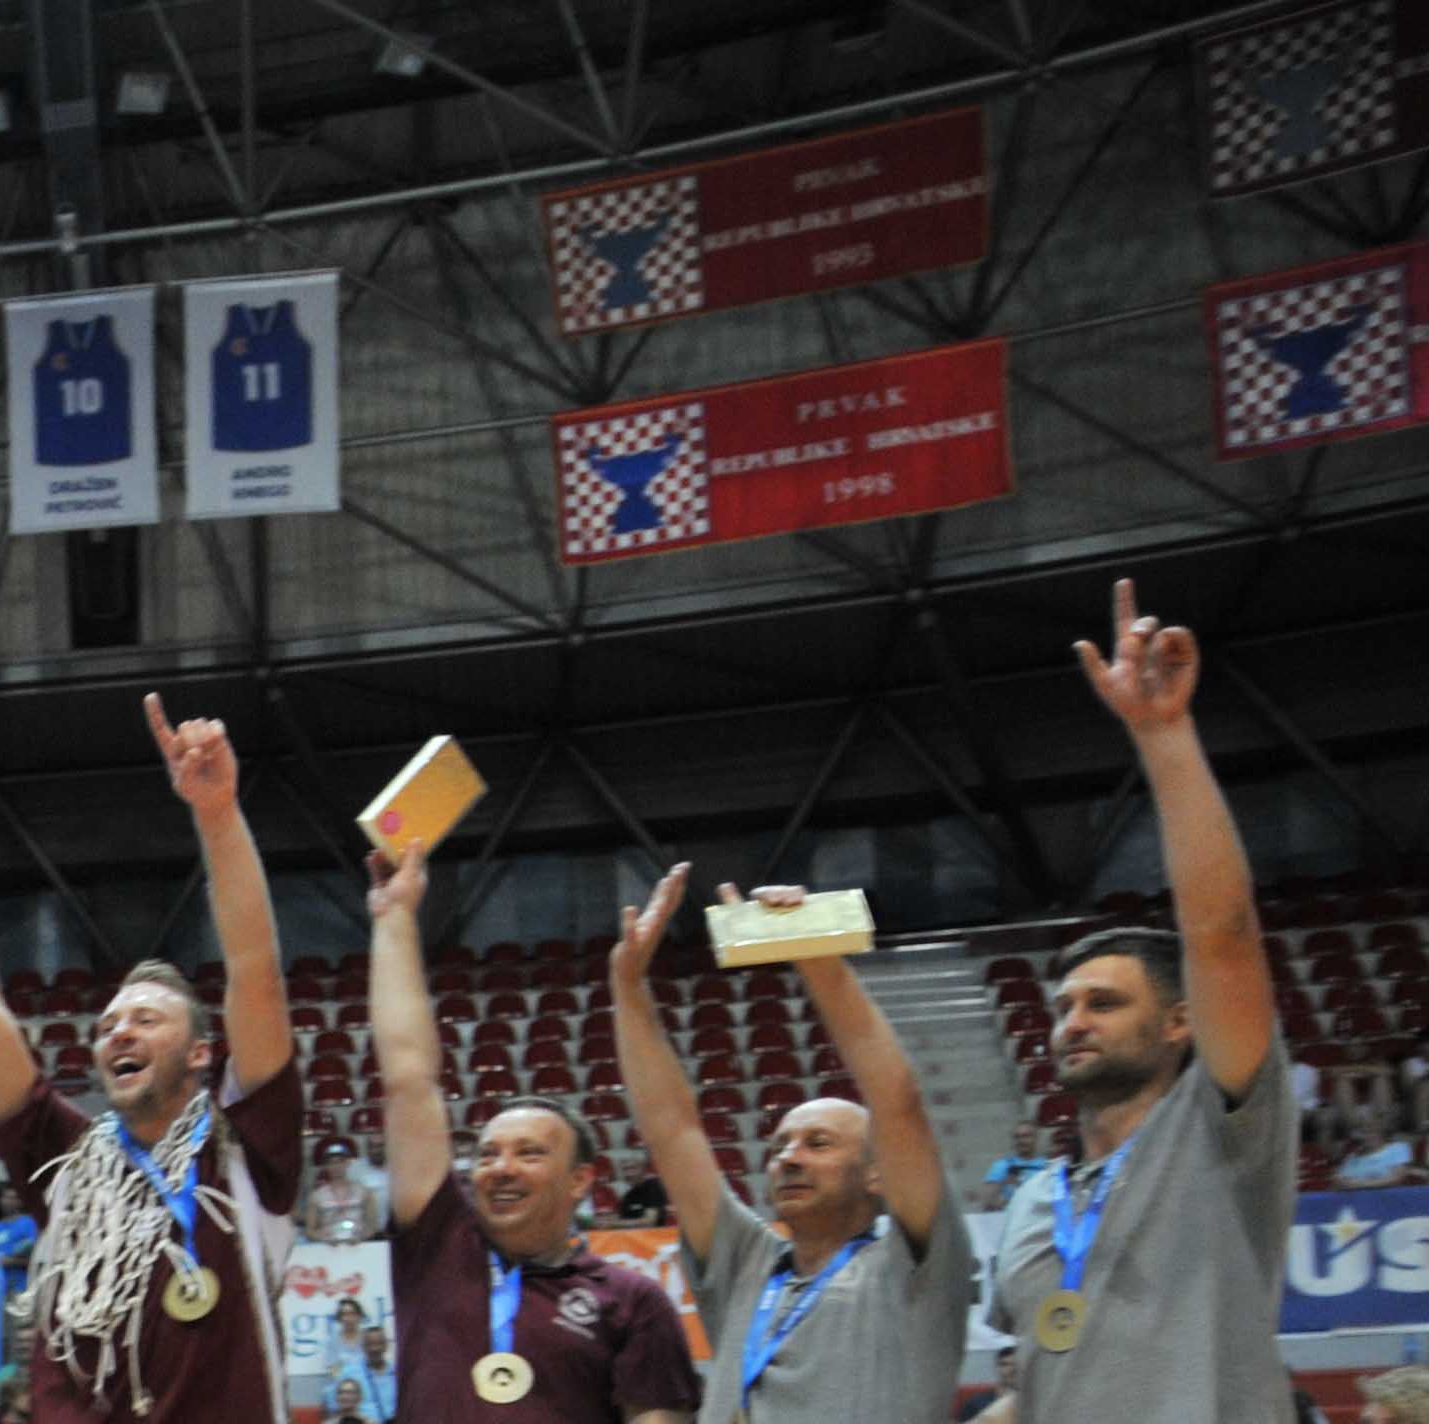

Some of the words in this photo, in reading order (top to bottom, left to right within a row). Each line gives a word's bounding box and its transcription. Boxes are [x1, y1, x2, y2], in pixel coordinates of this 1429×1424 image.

[59, 378, 104, 416] 10
[241, 361, 283, 402] 11
[797, 386, 907, 422] PRVAK
[709, 437, 850, 477] REPUBLIKE
